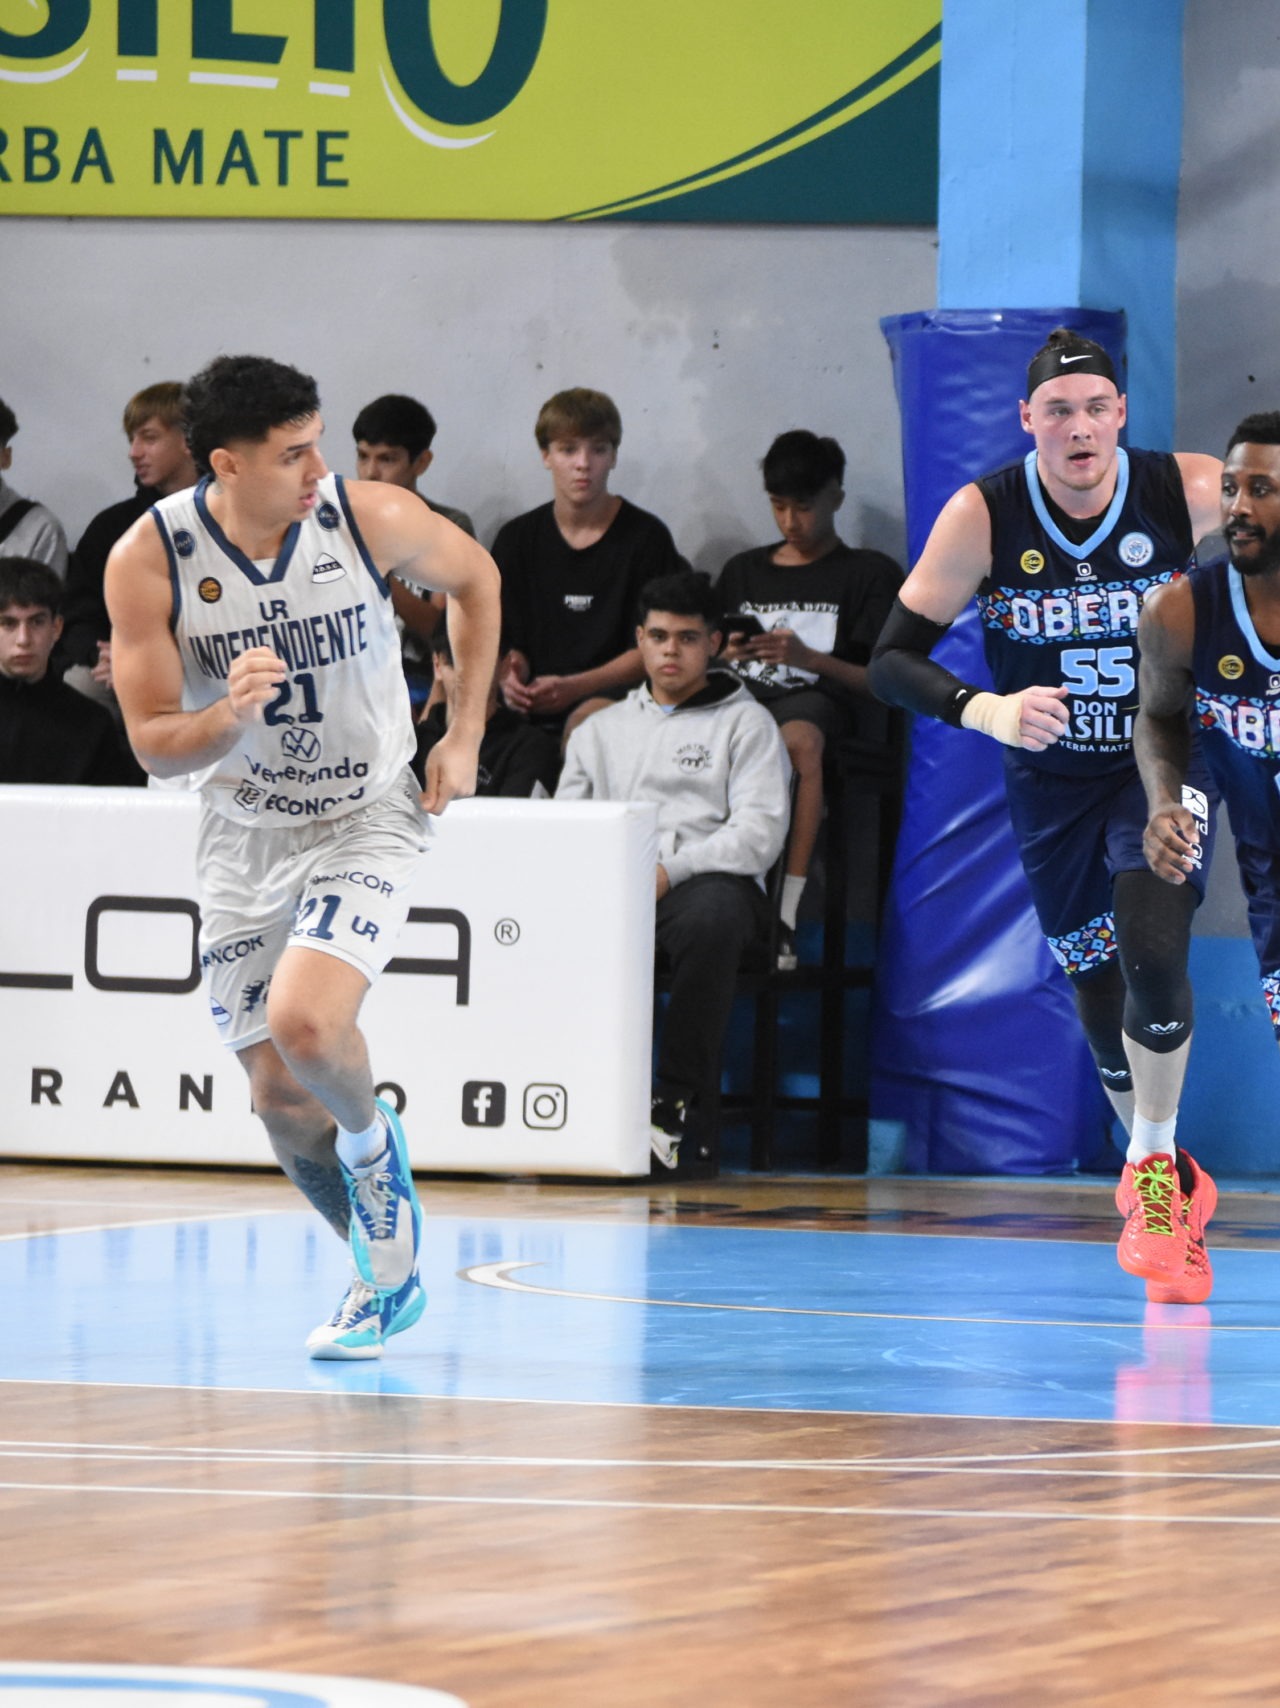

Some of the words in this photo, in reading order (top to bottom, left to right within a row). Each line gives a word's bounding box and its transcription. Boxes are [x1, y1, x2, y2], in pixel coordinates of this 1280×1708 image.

[0, 127, 114, 184] BA
[152, 128, 350, 187] MATE
[1011, 584, 1164, 638] OBER
[1060, 646, 1135, 697] 55
[263, 672, 324, 726] 21
[1073, 699, 1118, 717] DON
[1058, 739, 1095, 752] YERBA
[351, 914, 380, 943] UR
